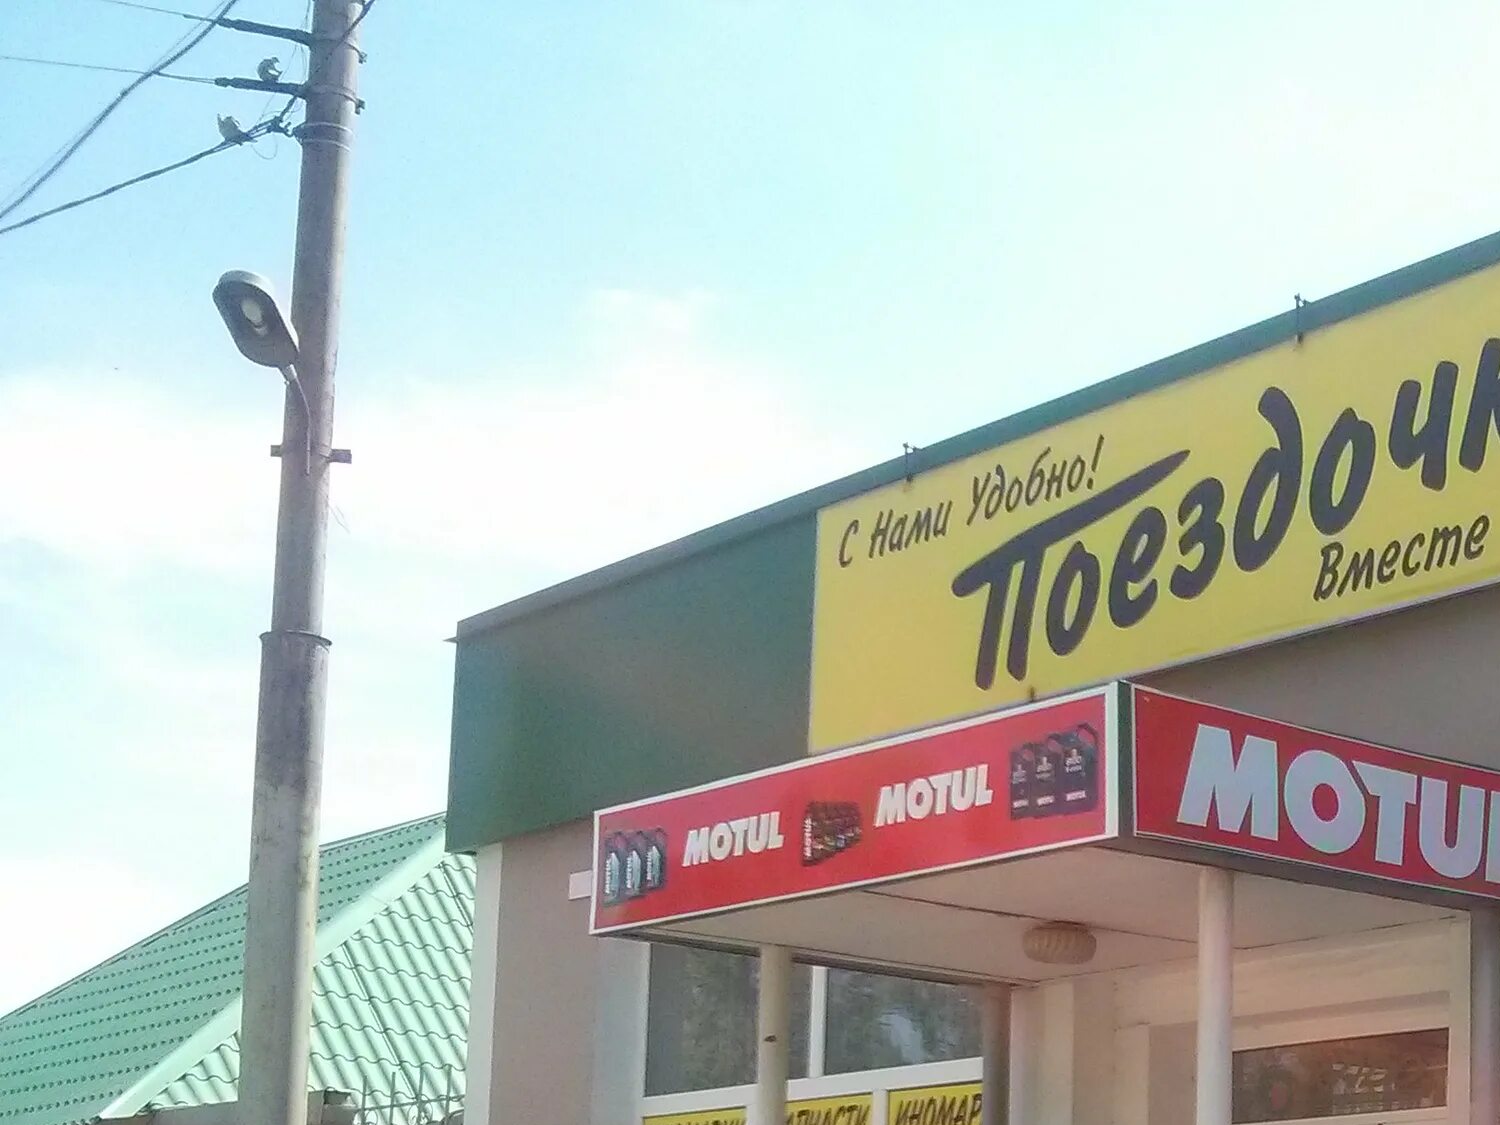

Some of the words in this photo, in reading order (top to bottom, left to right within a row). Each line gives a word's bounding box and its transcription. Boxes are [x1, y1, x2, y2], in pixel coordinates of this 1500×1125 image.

[869, 500, 953, 559] Нами
[966, 434, 1102, 526] Удобно!
[1313, 513, 1491, 601] Вместе
[873, 763, 994, 828] MOTUL
[681, 810, 785, 868] MOTUL
